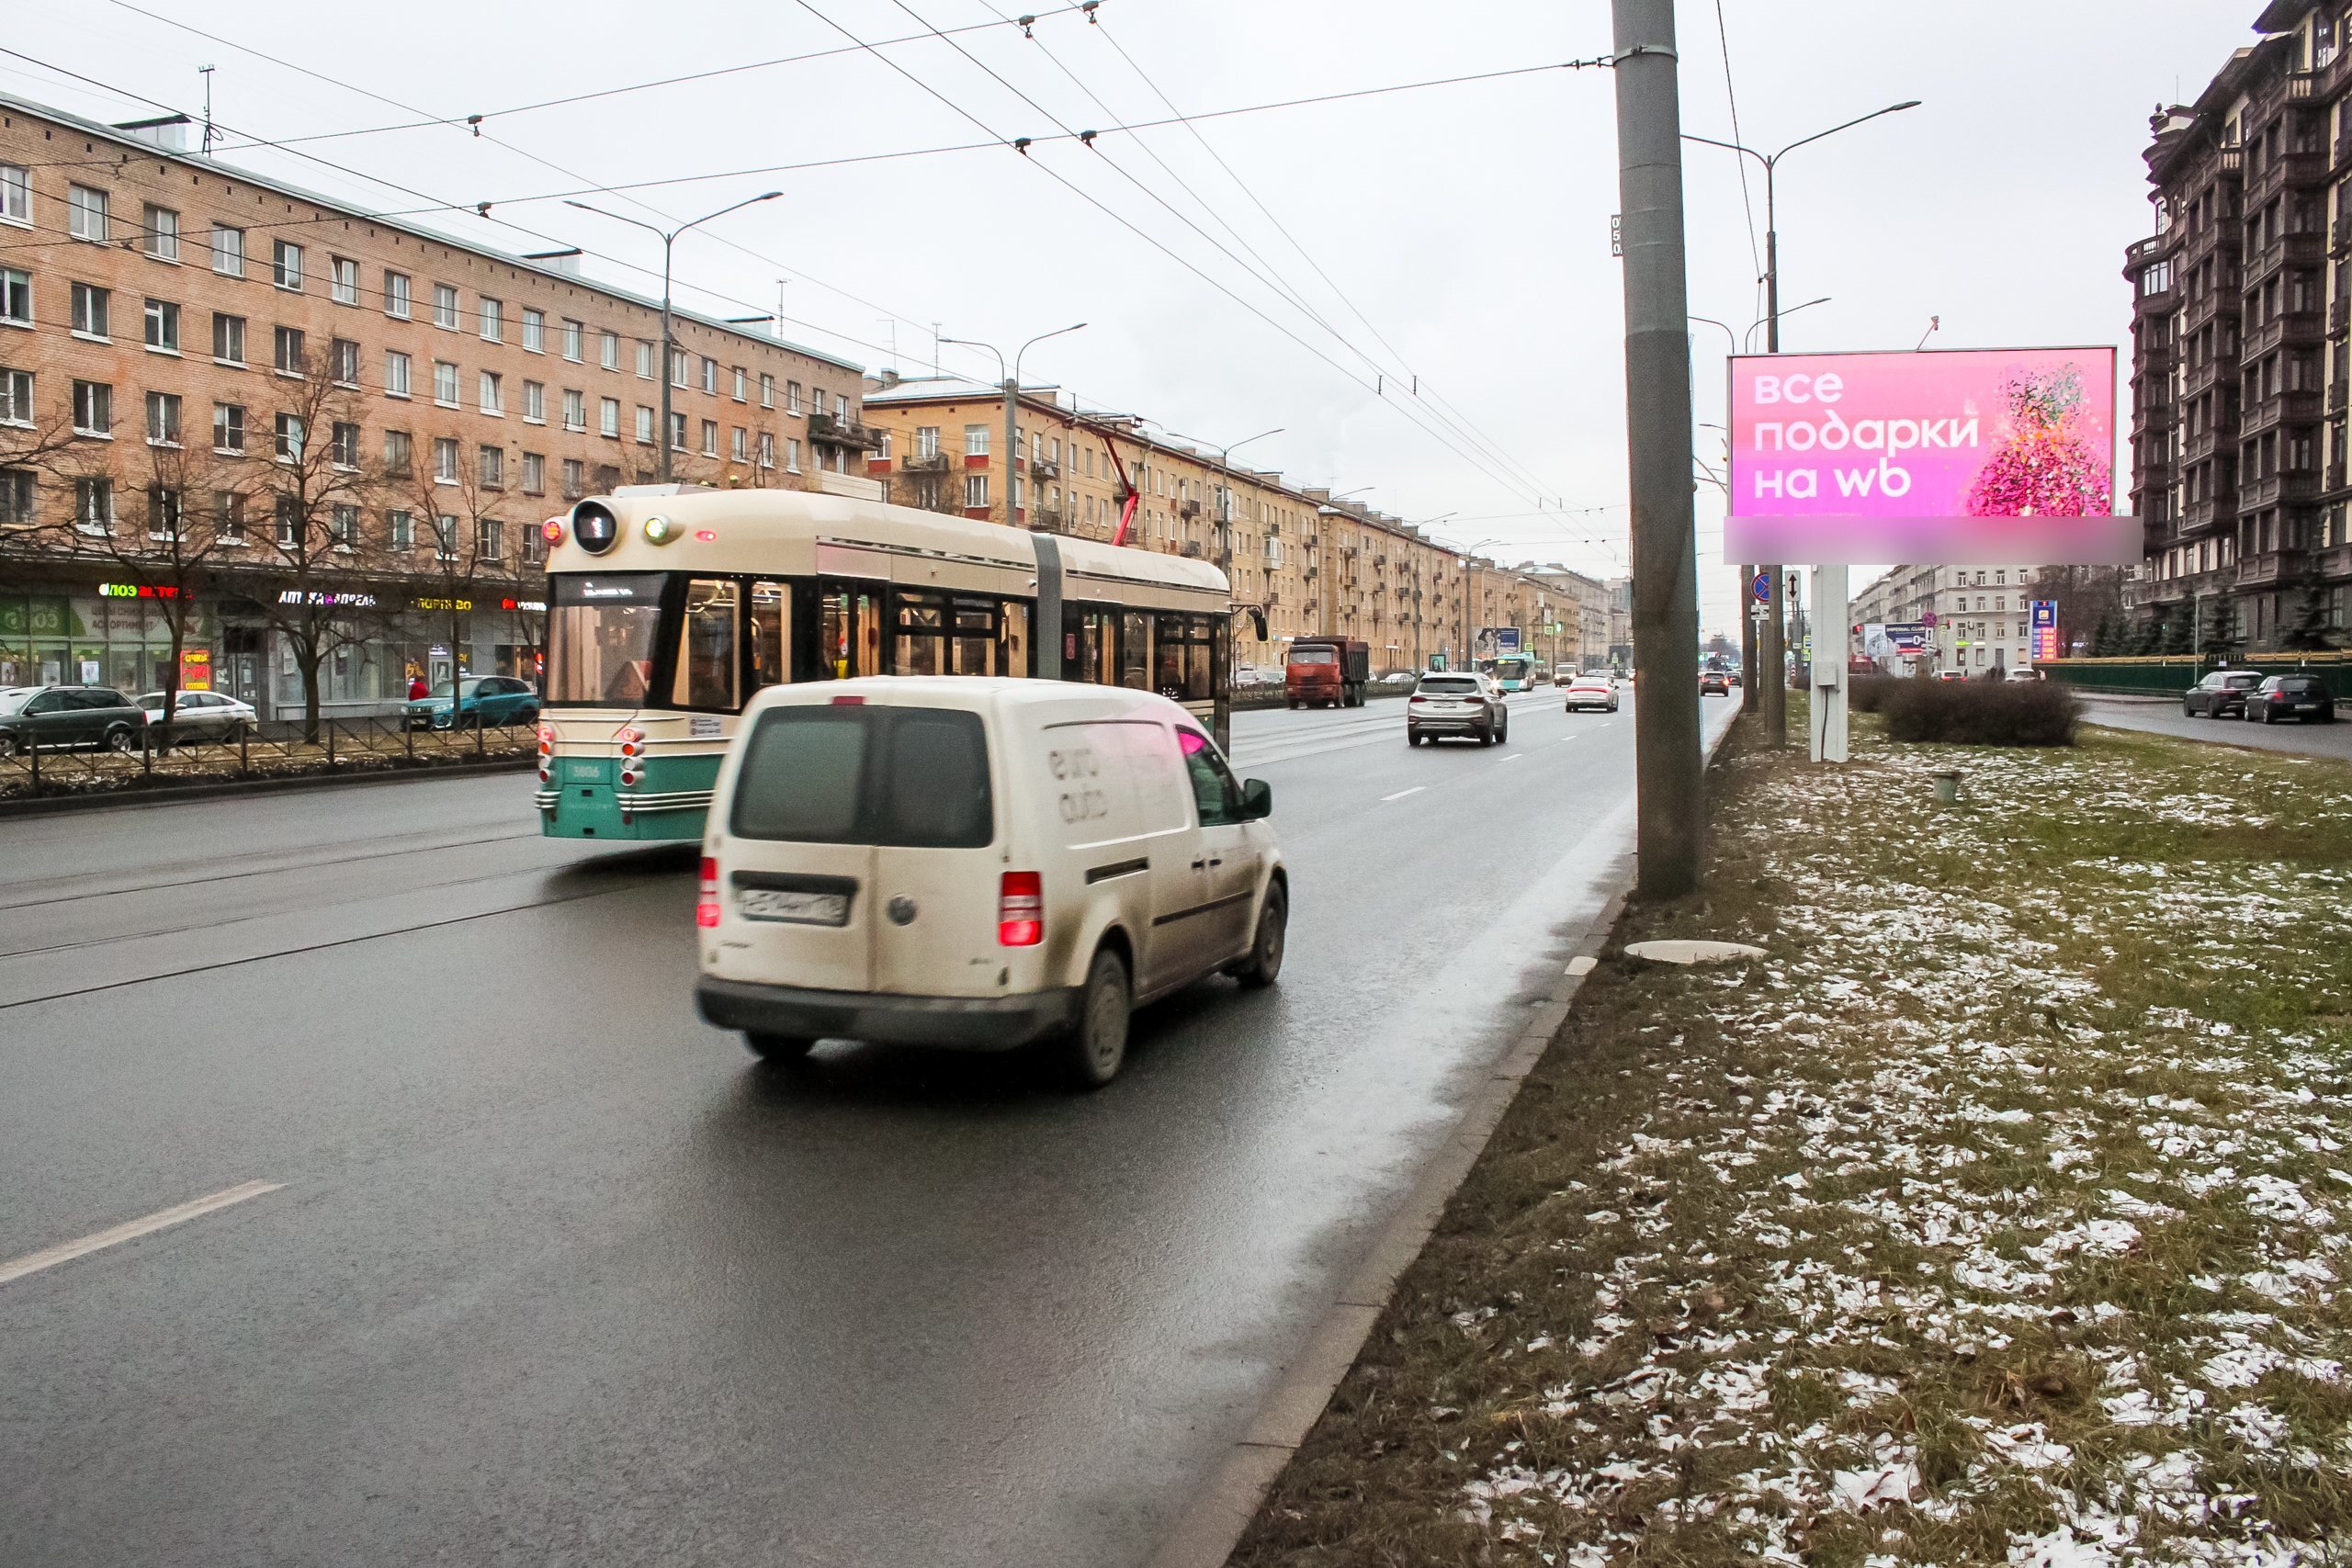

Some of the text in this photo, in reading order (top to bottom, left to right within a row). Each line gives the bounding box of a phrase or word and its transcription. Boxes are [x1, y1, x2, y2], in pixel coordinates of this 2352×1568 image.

[1755, 372, 1844, 404] все
[1755, 409, 1979, 457] подарки
[1755, 457, 1912, 499] на wb
